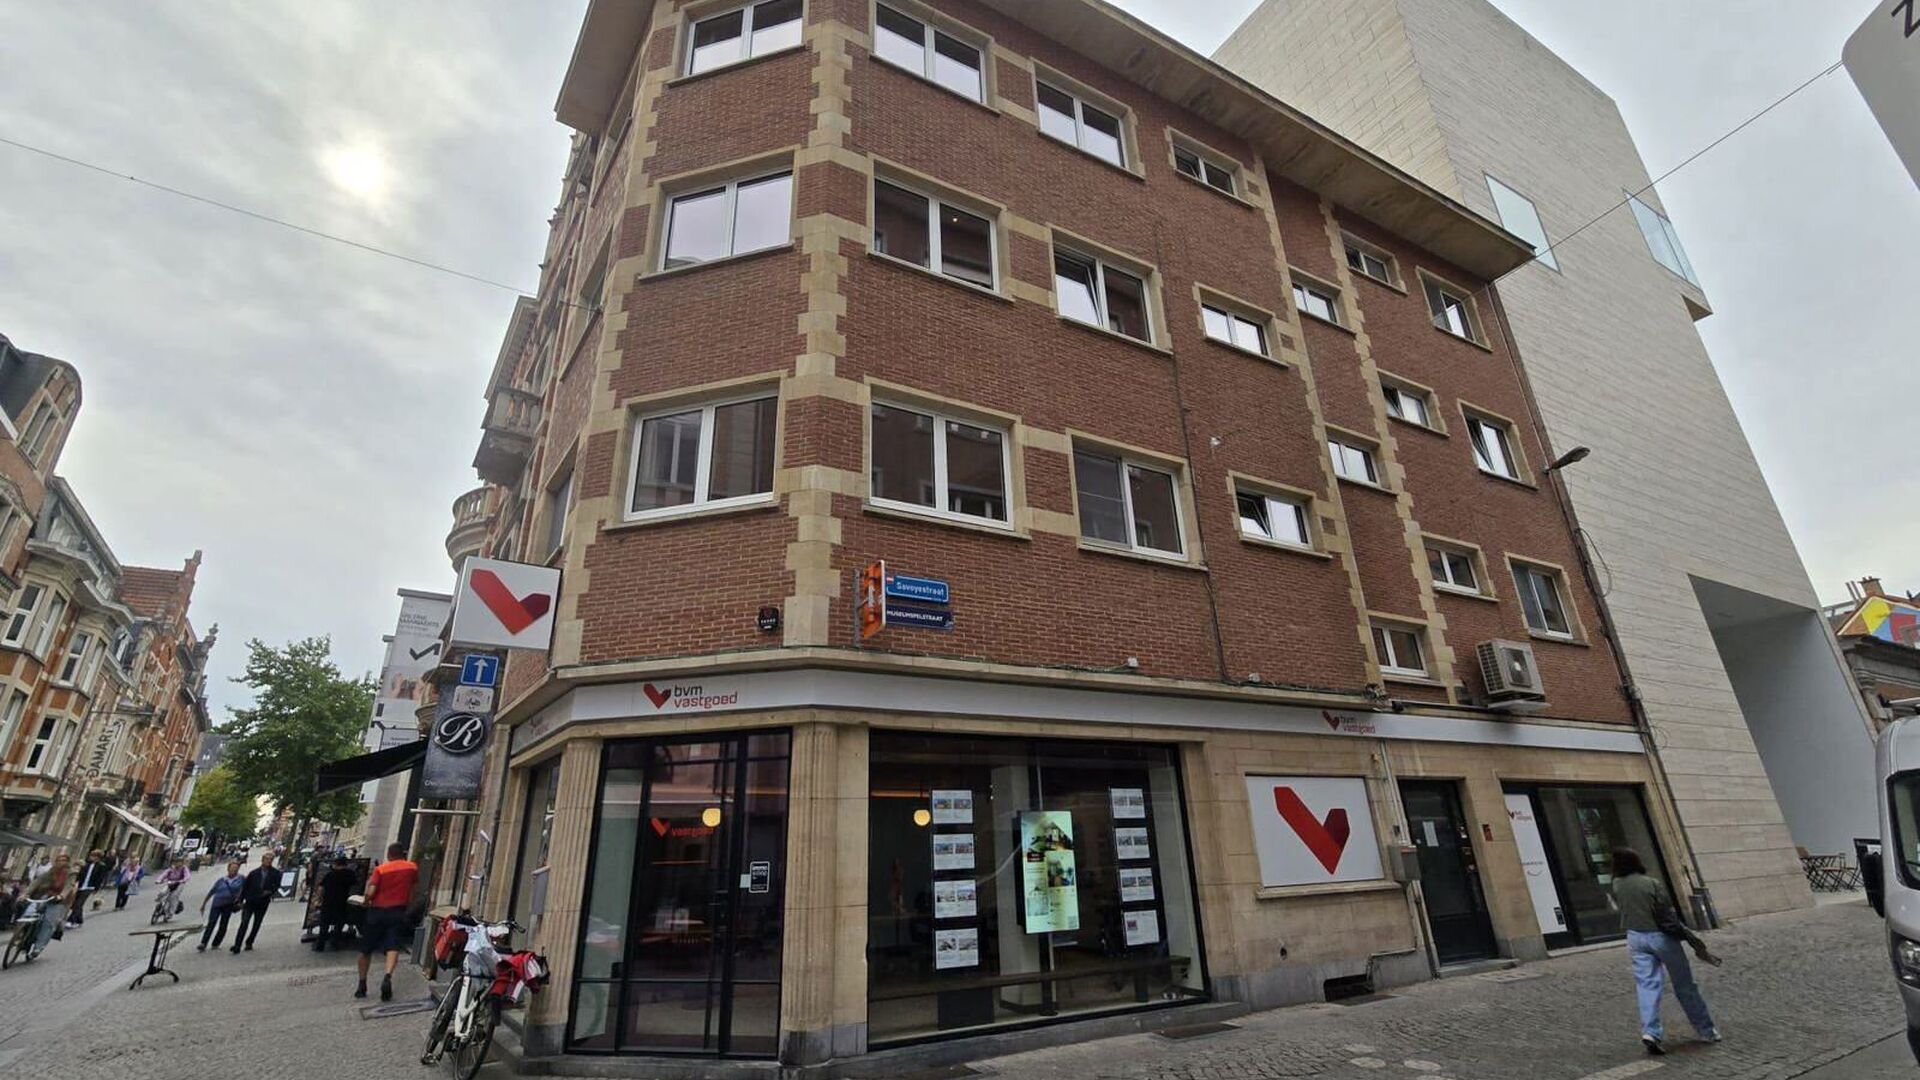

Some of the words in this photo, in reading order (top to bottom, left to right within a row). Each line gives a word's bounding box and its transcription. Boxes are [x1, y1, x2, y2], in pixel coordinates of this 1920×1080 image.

[896, 582, 945, 596] Savoyestraat
[674, 685, 702, 697] bvm
[674, 692, 737, 709] vastgoed
[85, 727, 115, 779] DAMART
